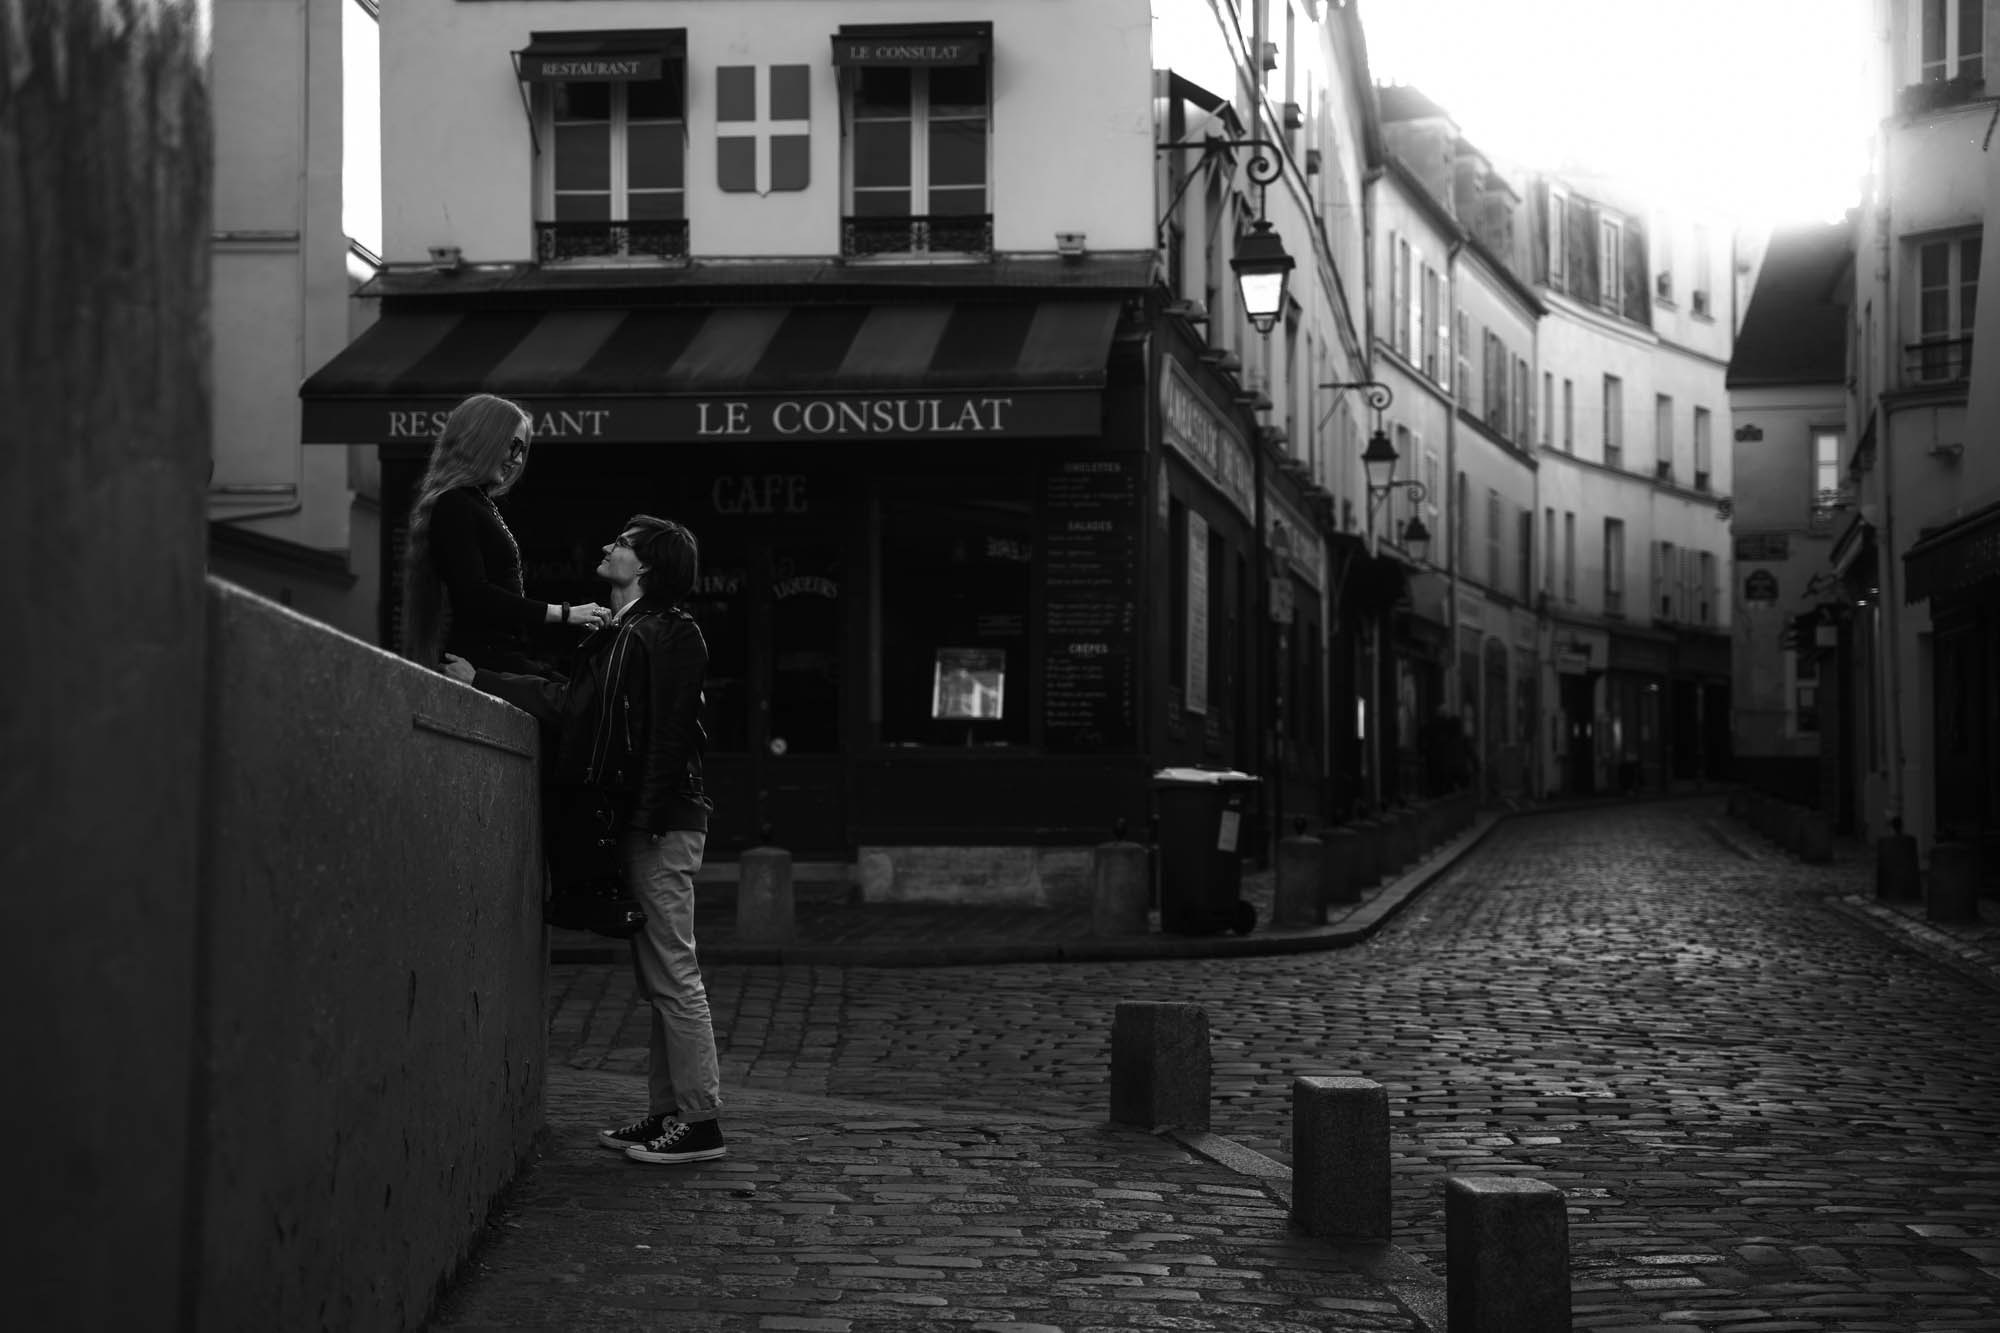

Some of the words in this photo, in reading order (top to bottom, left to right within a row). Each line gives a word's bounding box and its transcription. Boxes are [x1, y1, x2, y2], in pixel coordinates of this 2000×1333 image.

[850, 45, 870, 59] LE
[875, 45, 960, 60] CONSULAT
[542, 62, 640, 76] RESTAURANT
[388, 410, 609, 438] RESANT
[697, 403, 750, 434] LE
[772, 398, 1012, 433] CONSULAT
